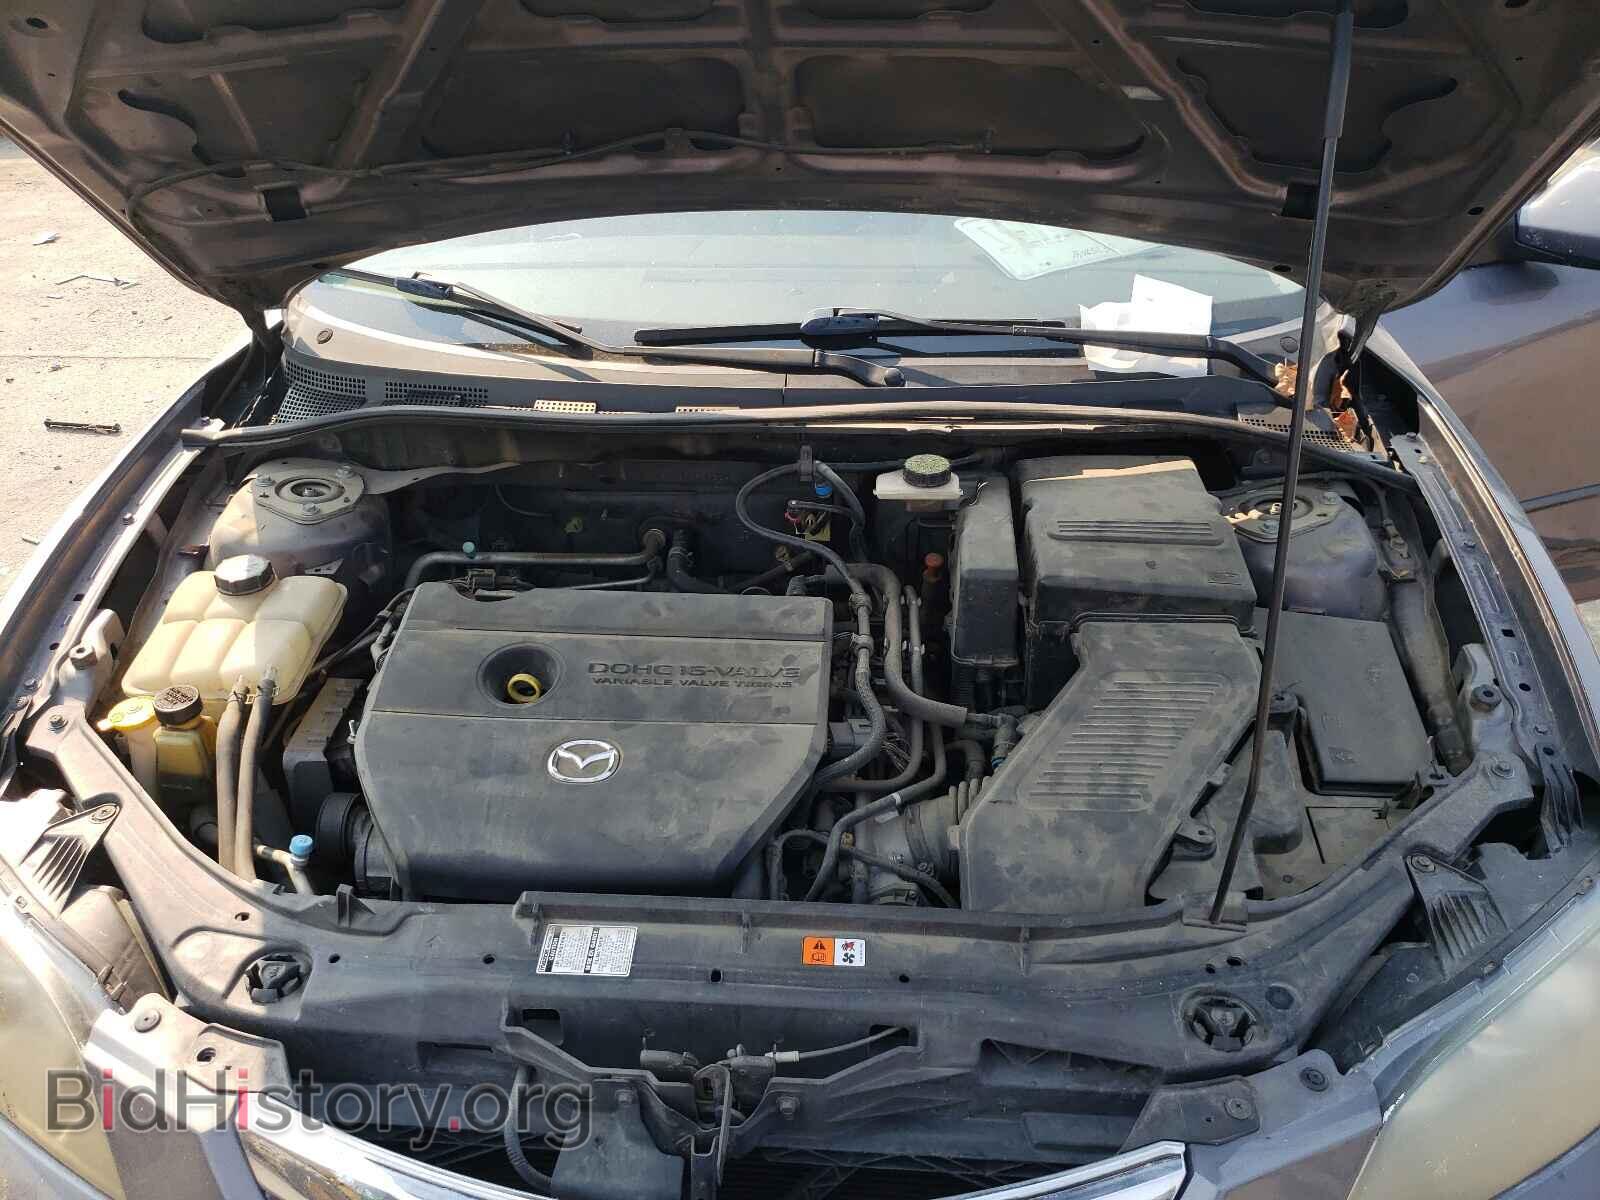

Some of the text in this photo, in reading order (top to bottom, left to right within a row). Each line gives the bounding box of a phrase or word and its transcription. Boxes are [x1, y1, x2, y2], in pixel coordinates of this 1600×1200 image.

[588, 662, 800, 678] DOHC 16-VALVE
[592, 677, 673, 686] VARIABLE
[679, 679, 729, 687] VALVE
